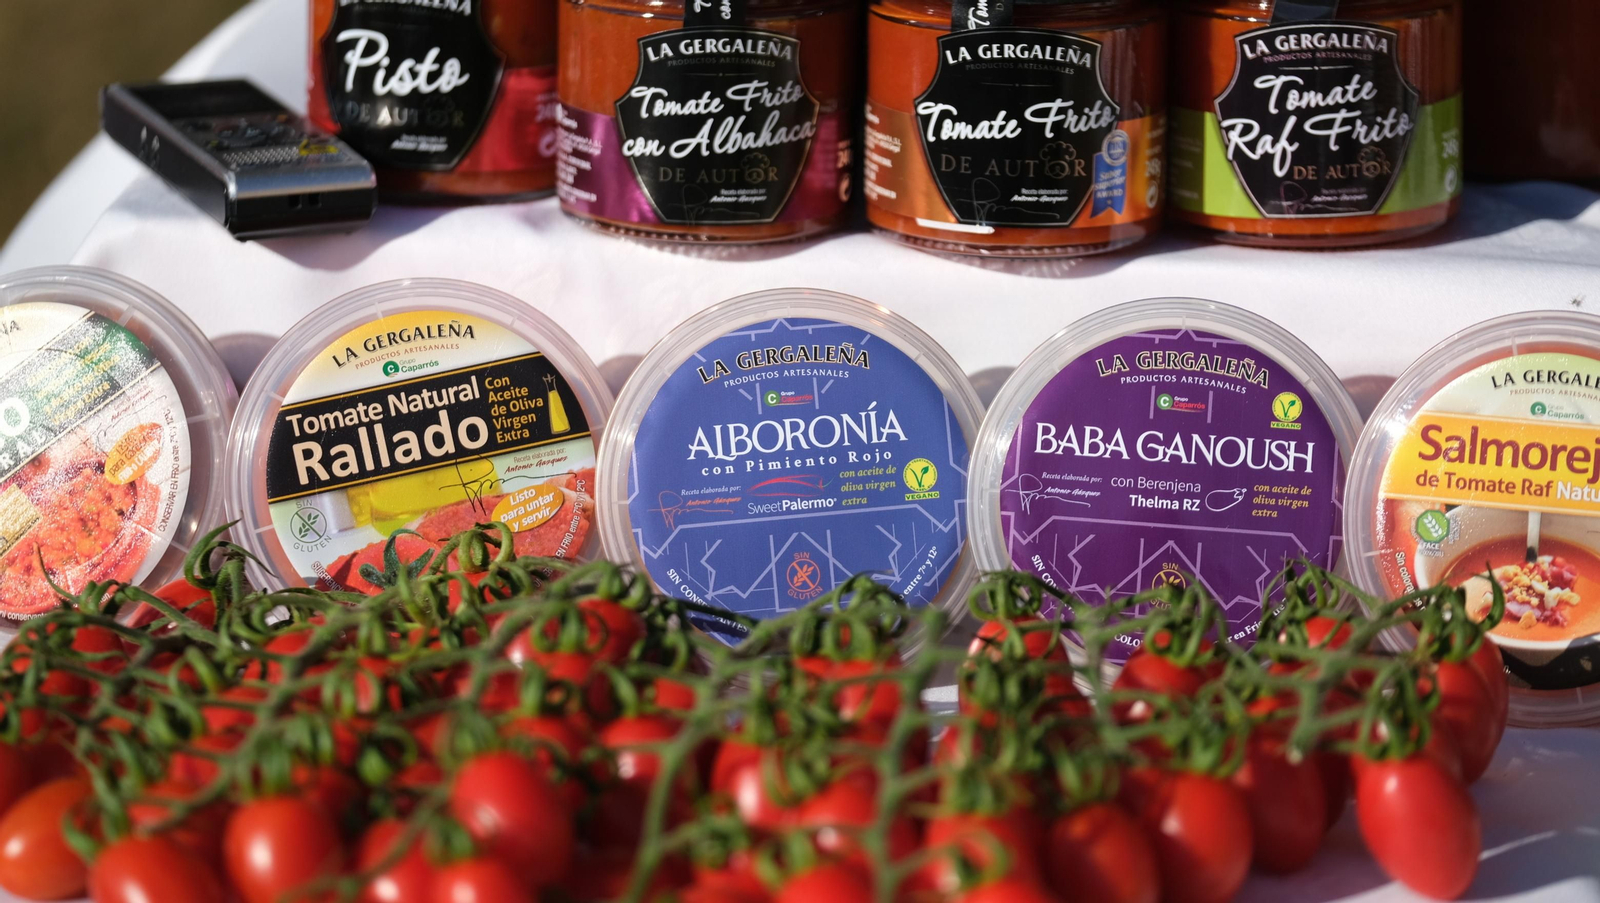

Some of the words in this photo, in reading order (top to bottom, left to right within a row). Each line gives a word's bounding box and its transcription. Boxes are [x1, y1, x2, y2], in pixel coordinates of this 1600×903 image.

[646, 43, 674, 62] LA
[679, 37, 792, 60] GERGALEÑA
[1242, 39, 1268, 60] LA
[1275, 32, 1388, 54] GERGALEÑA
[336, 28, 470, 97] Pisto
[668, 57, 717, 67] PRODUCTOS
[945, 46, 971, 65] LA
[977, 44, 1092, 69] GERGALEÑA
[630, 86, 725, 119] Tomate
[726, 80, 805, 112] Frito
[1253, 74, 1378, 114] Tomate
[916, 101, 1022, 142] Tomate
[1024, 98, 1116, 138] Frito
[622, 136, 666, 158] con
[669, 110, 816, 159] Albahaca
[1220, 115, 1299, 178] Raf
[1303, 107, 1414, 151] Frito
[659, 167, 685, 183] DE
[698, 166, 779, 185] AUTOR
[941, 154, 972, 174] DE
[984, 157, 1087, 179] AUTOR
[1293, 166, 1317, 181] DE
[332, 347, 359, 368] LA
[363, 320, 475, 353] GERGALEÑA
[355, 351, 401, 370] PRODUCTOS
[404, 344, 460, 355] ARTESANALES
[696, 358, 731, 384] LA
[736, 341, 870, 371] GERGALEÑA
[400, 360, 439, 374] Caparrós
[1095, 354, 1130, 377] LA
[1136, 351, 1270, 389] GERGALEÑA
[485, 376, 511, 389] Con
[724, 371, 779, 388] PRODUCTOS
[783, 368, 849, 379] ARTESANALES
[1121, 374, 1176, 385] PRODUCTOS
[1181, 376, 1247, 395] ARTESANALES
[1491, 372, 1516, 389] LA
[1523, 370, 1600, 391] GERGALE
[488, 386, 529, 404] Aceite
[1510, 388, 1555, 396] PRODUCTOS
[1559, 389, 1600, 402] ARTESANA
[286, 402, 384, 437] Tomate
[387, 375, 480, 418] Natural
[491, 404, 507, 417] de
[509, 397, 544, 413] Oliva
[1547, 409, 1585, 420] Caparrós
[492, 412, 537, 430] Virgen
[687, 400, 908, 461] ALBORONÍA
[496, 428, 530, 444] Extra
[292, 410, 489, 486] Rallado
[1034, 422, 1130, 460] BABA
[1136, 430, 1316, 473] GANOUSH
[1418, 424, 1600, 484] Salmorej
[504, 463, 533, 474] Antonio
[701, 463, 735, 477] con
[746, 455, 838, 473] Pimiento
[848, 448, 892, 464] Rojo
[840, 470, 855, 478] con
[857, 467, 884, 477] aceite
[886, 465, 897, 474] de
[841, 482, 863, 492] oliva
[865, 480, 896, 491] virgen
[1061, 474, 1090, 482] elaborada
[1111, 476, 1134, 488] con
[1138, 476, 1201, 494] Berenjena
[1416, 470, 1440, 487] de
[1444, 472, 1517, 494] Tomate
[1521, 478, 1554, 497] Raf
[1556, 480, 1600, 502] Natu
[509, 487, 536, 506] Listo
[681, 488, 700, 497] Receta
[701, 486, 729, 495] elaborada
[905, 492, 939, 500] VEGANO
[1254, 484, 1270, 493] con
[1272, 484, 1299, 495] aceite
[1300, 486, 1312, 496] de
[296, 499, 313, 509] SIN
[500, 506, 525, 524] para
[526, 491, 555, 511] untar
[842, 496, 868, 506] extra
[1129, 494, 1179, 510] Thelma
[1183, 499, 1200, 511] RZ
[1253, 495, 1276, 505] oliva
[1278, 496, 1309, 509] virgen
[512, 521, 520, 532] y
[521, 506, 551, 527] servir
[1252, 508, 1278, 518] extra
[293, 535, 332, 553] GLUTEN
[556, 547, 565, 559] EN
[561, 532, 574, 551] FRIO
[570, 515, 580, 533] entre
[793, 552, 810, 560] SIN
[1031, 554, 1045, 572] SIN
[1396, 551, 1405, 566] Sin
[1162, 562, 1179, 571] SIN
[667, 568, 682, 585] SIN
[903, 574, 922, 595] entre
[925, 558, 933, 568] y
[787, 585, 823, 600] GLUTEN
[1234, 630, 1246, 641] en
